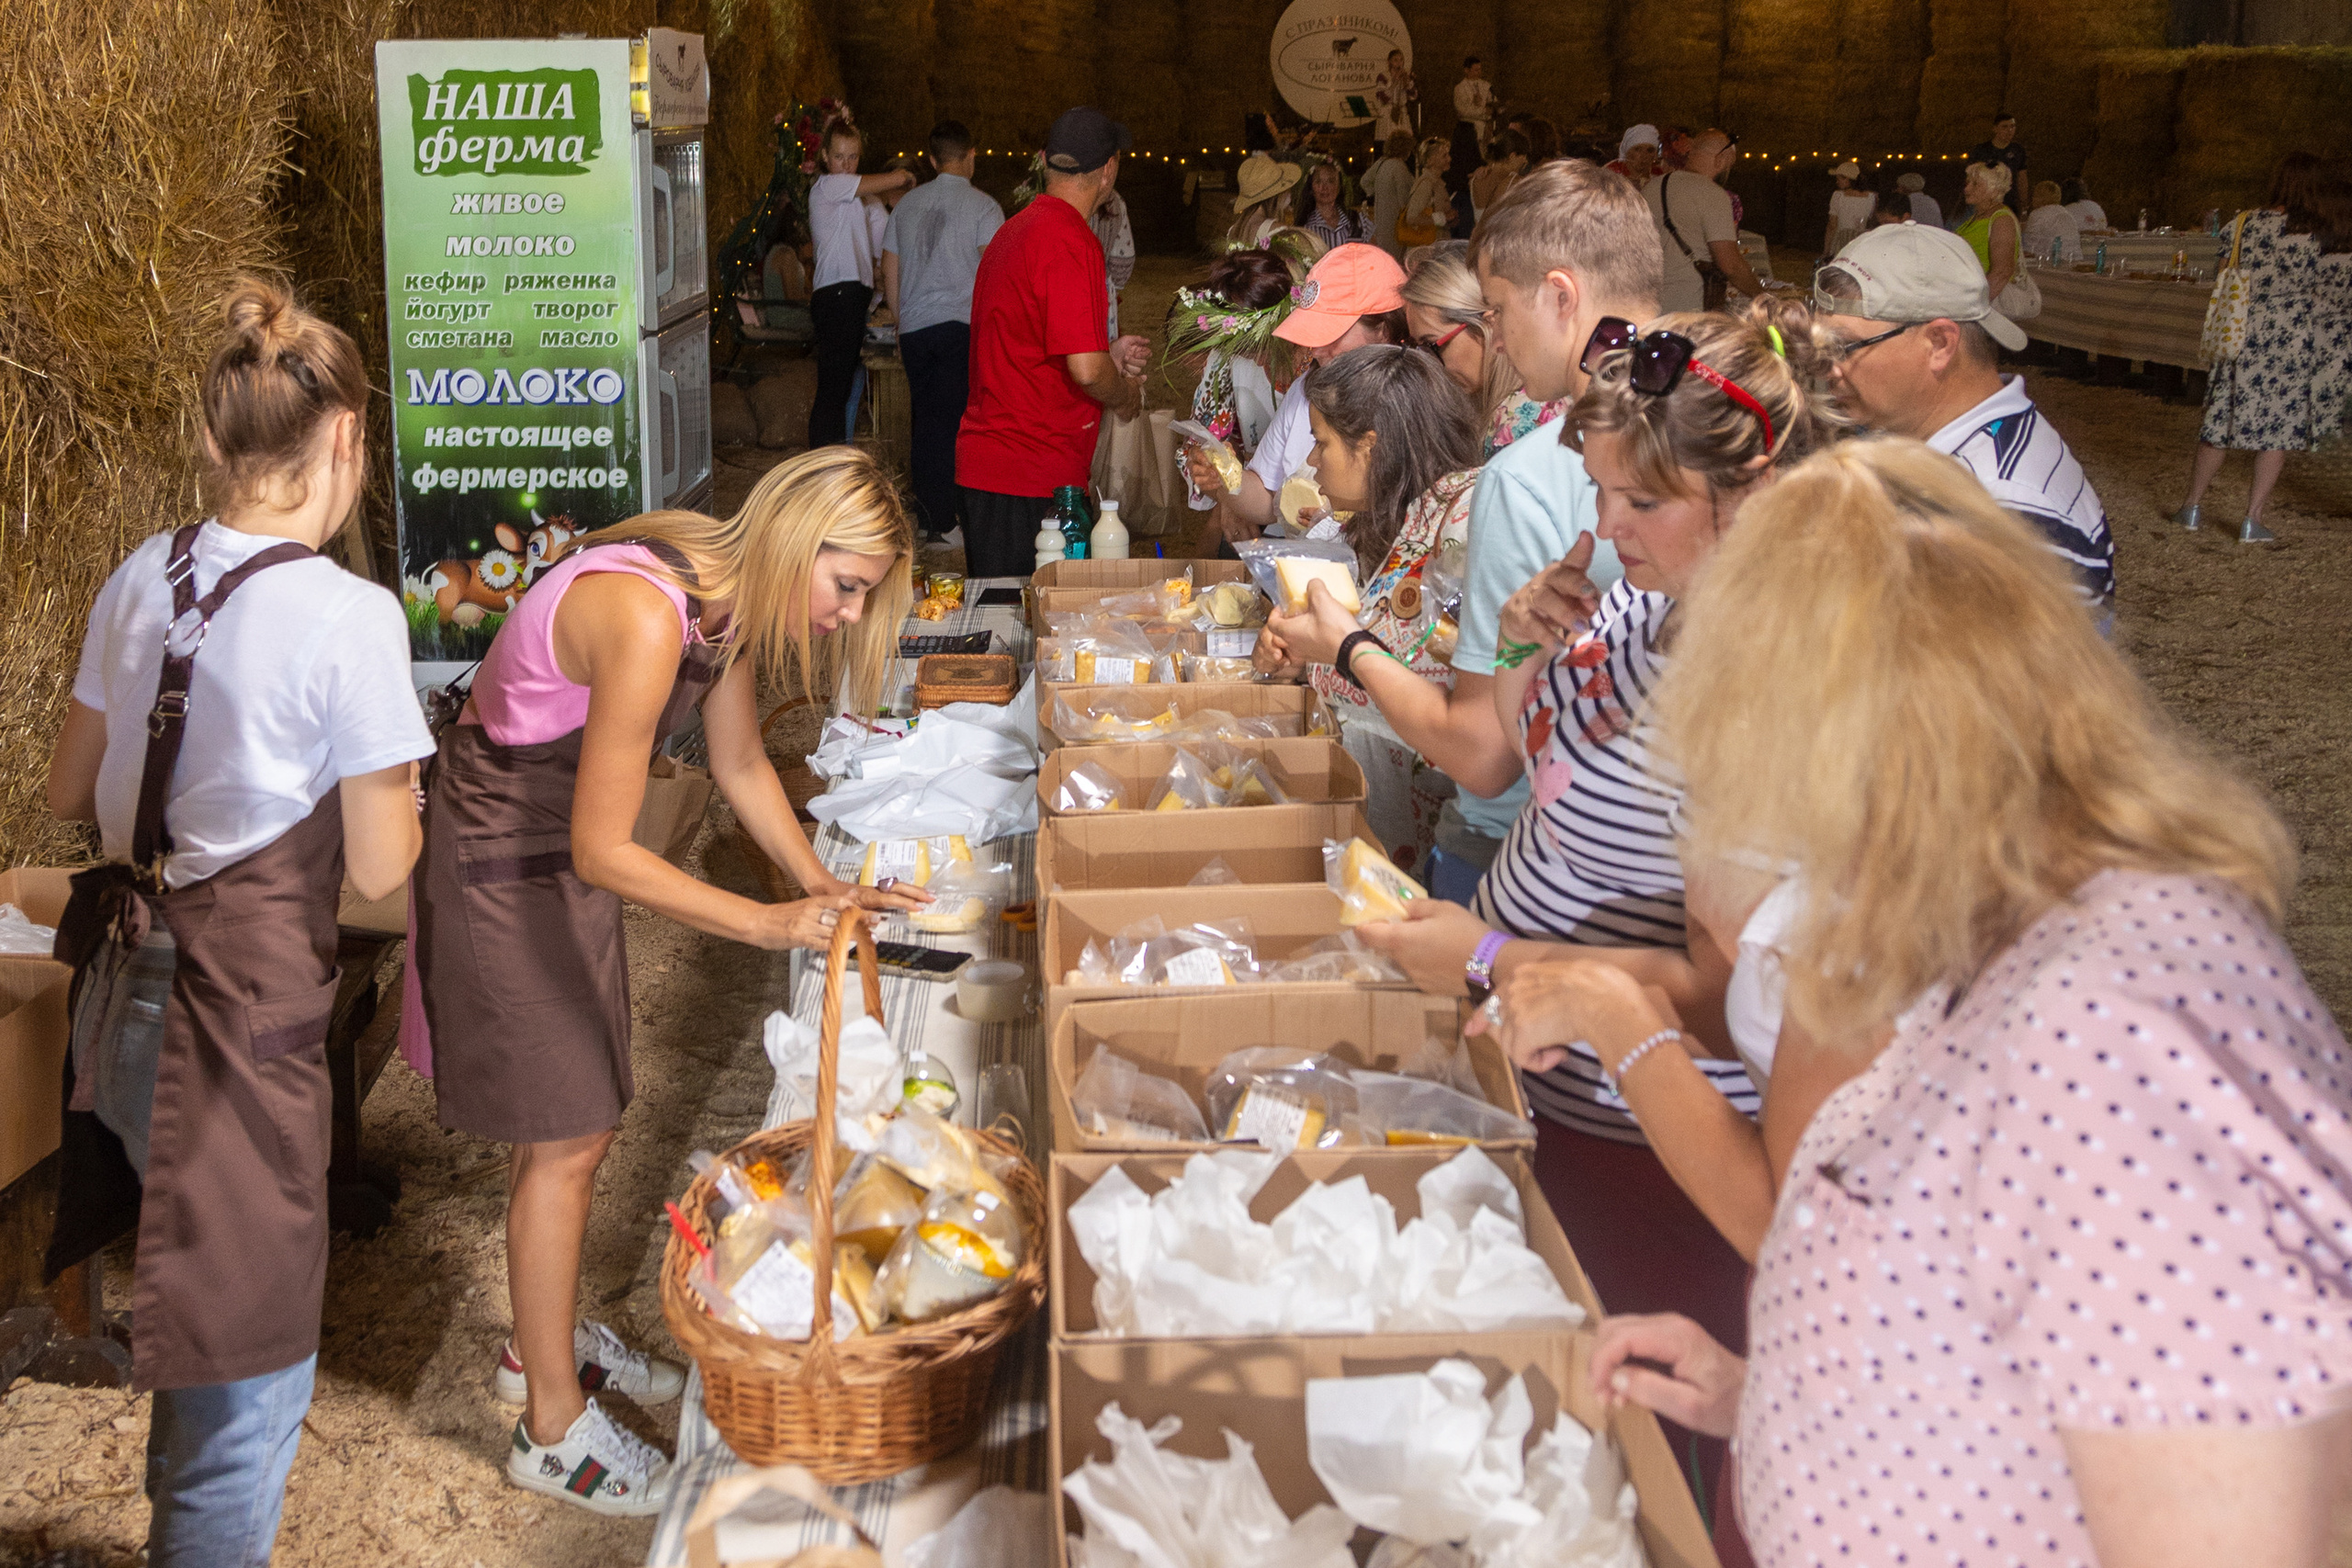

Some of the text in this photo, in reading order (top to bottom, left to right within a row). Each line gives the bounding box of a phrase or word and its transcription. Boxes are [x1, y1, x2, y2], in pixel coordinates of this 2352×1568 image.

[423, 84, 576, 121] НАША
[418, 127, 584, 173] ферма
[450, 191, 566, 215] живое
[445, 234, 576, 258] молоко
[404, 271, 617, 295] кефир ряженка
[405, 298, 619, 324] йогурт творог
[406, 330, 620, 349] сметана масло
[406, 367, 626, 406] МОЛОКО
[424, 423, 614, 450] настоящее
[412, 462, 629, 494] фермерское
